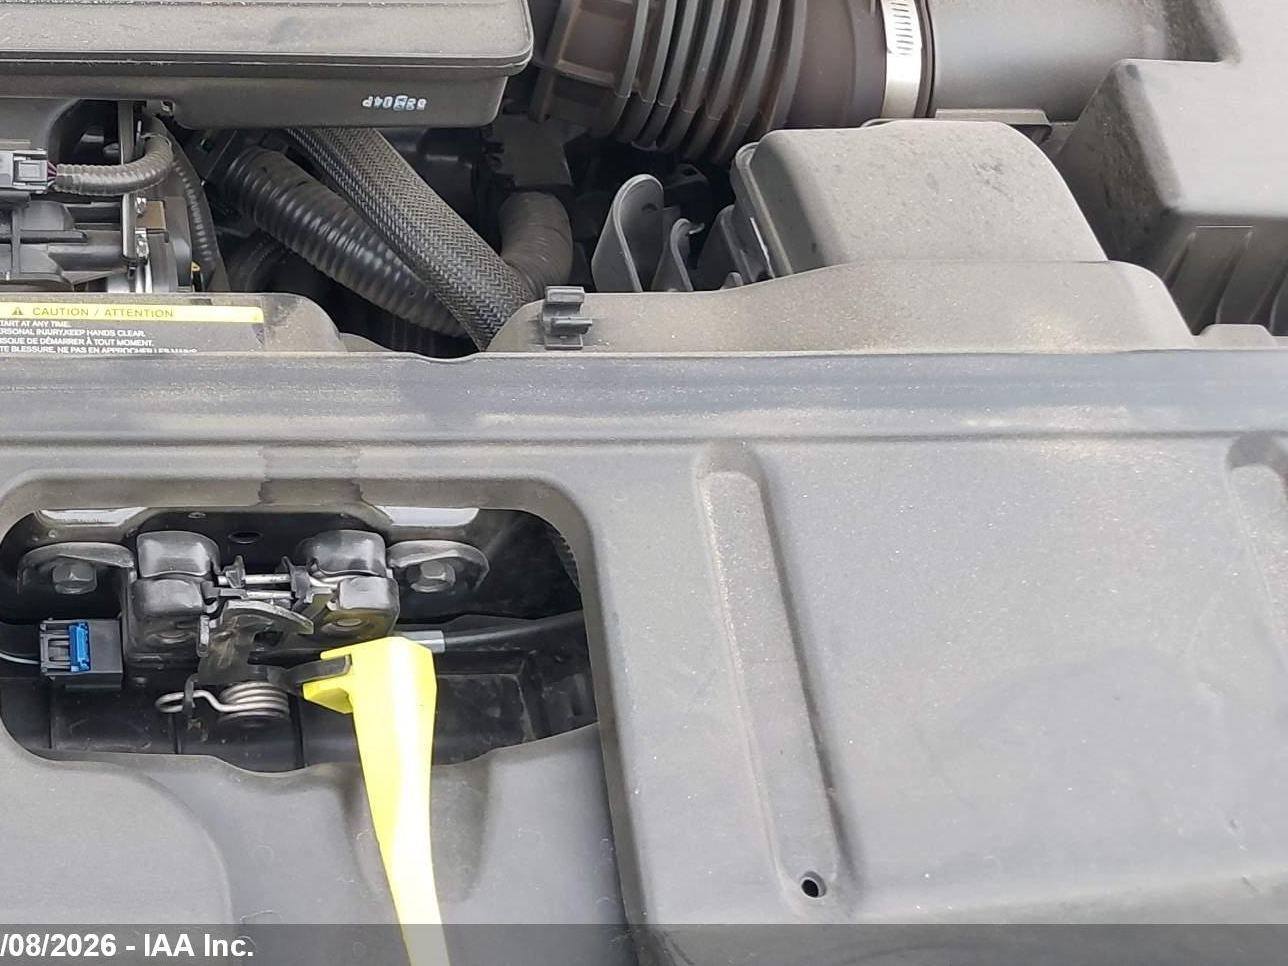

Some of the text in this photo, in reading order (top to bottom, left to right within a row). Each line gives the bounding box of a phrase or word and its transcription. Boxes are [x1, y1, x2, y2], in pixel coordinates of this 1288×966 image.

[32, 307, 89, 316] CAUTION
[104, 309, 174, 318] ATTENTION
[40, 336, 85, 345] DÉMARRER
